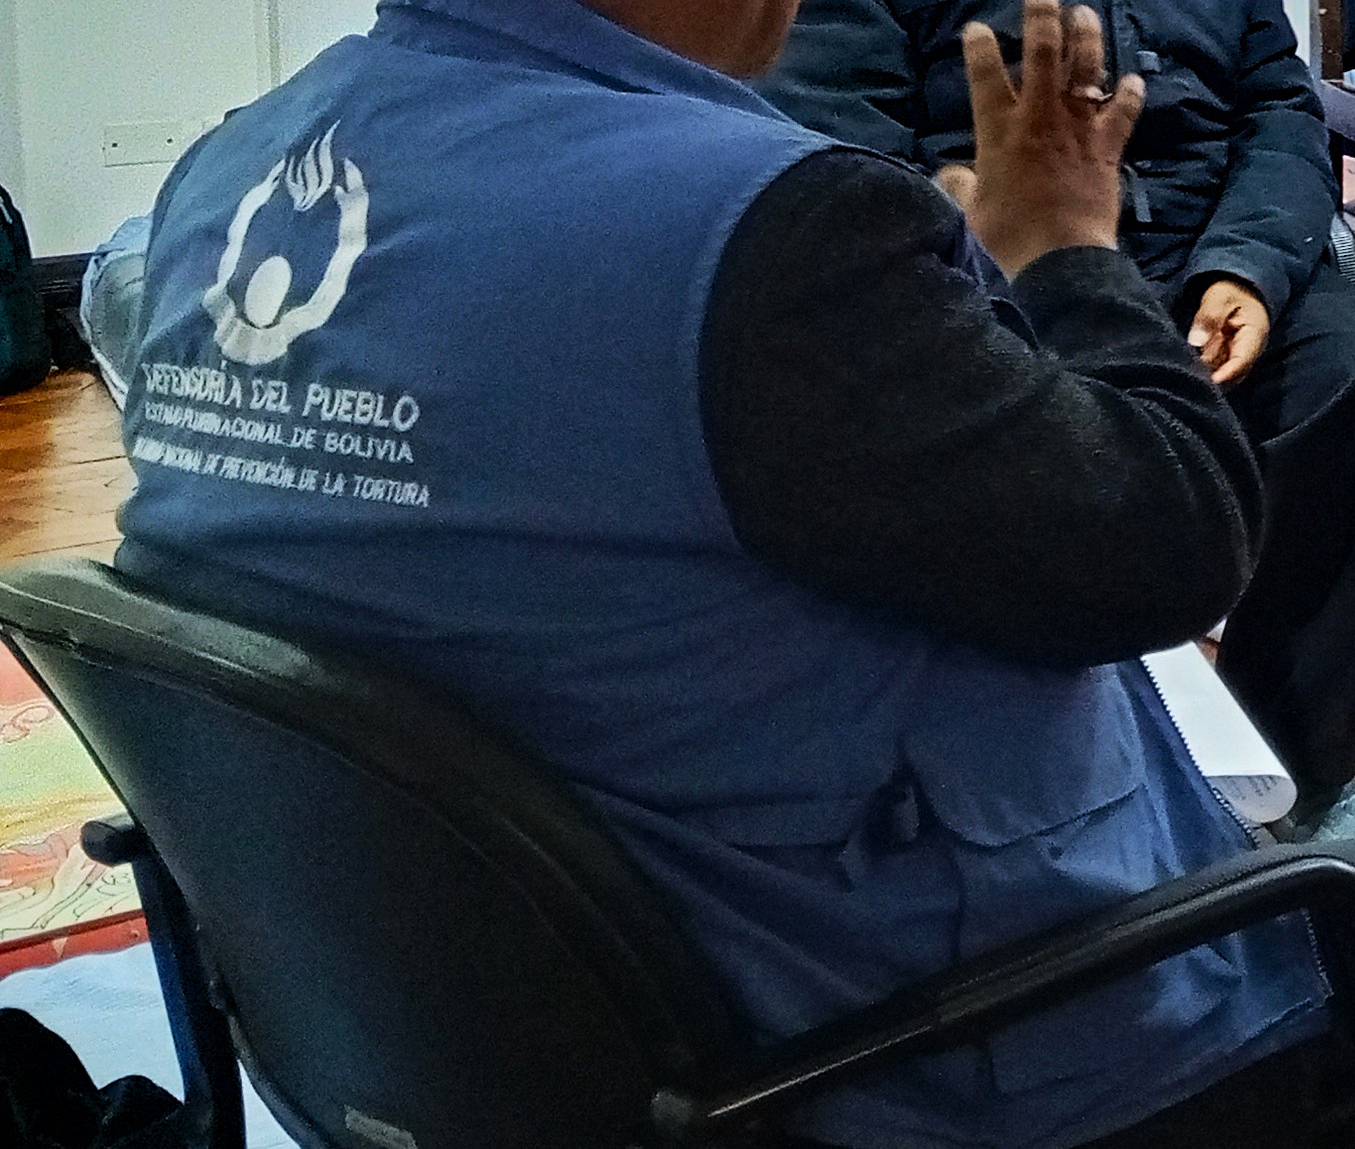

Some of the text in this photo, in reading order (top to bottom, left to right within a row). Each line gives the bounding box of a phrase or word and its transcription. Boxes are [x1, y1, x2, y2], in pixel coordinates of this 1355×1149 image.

[251, 378, 292, 414] DEL
[302, 382, 421, 433] PUEBLO
[288, 425, 317, 450] DE
[324, 431, 415, 464] BOLIVIA
[298, 468, 319, 492] DE
[322, 471, 346, 497] LA
[352, 474, 430, 508] TORTURA
